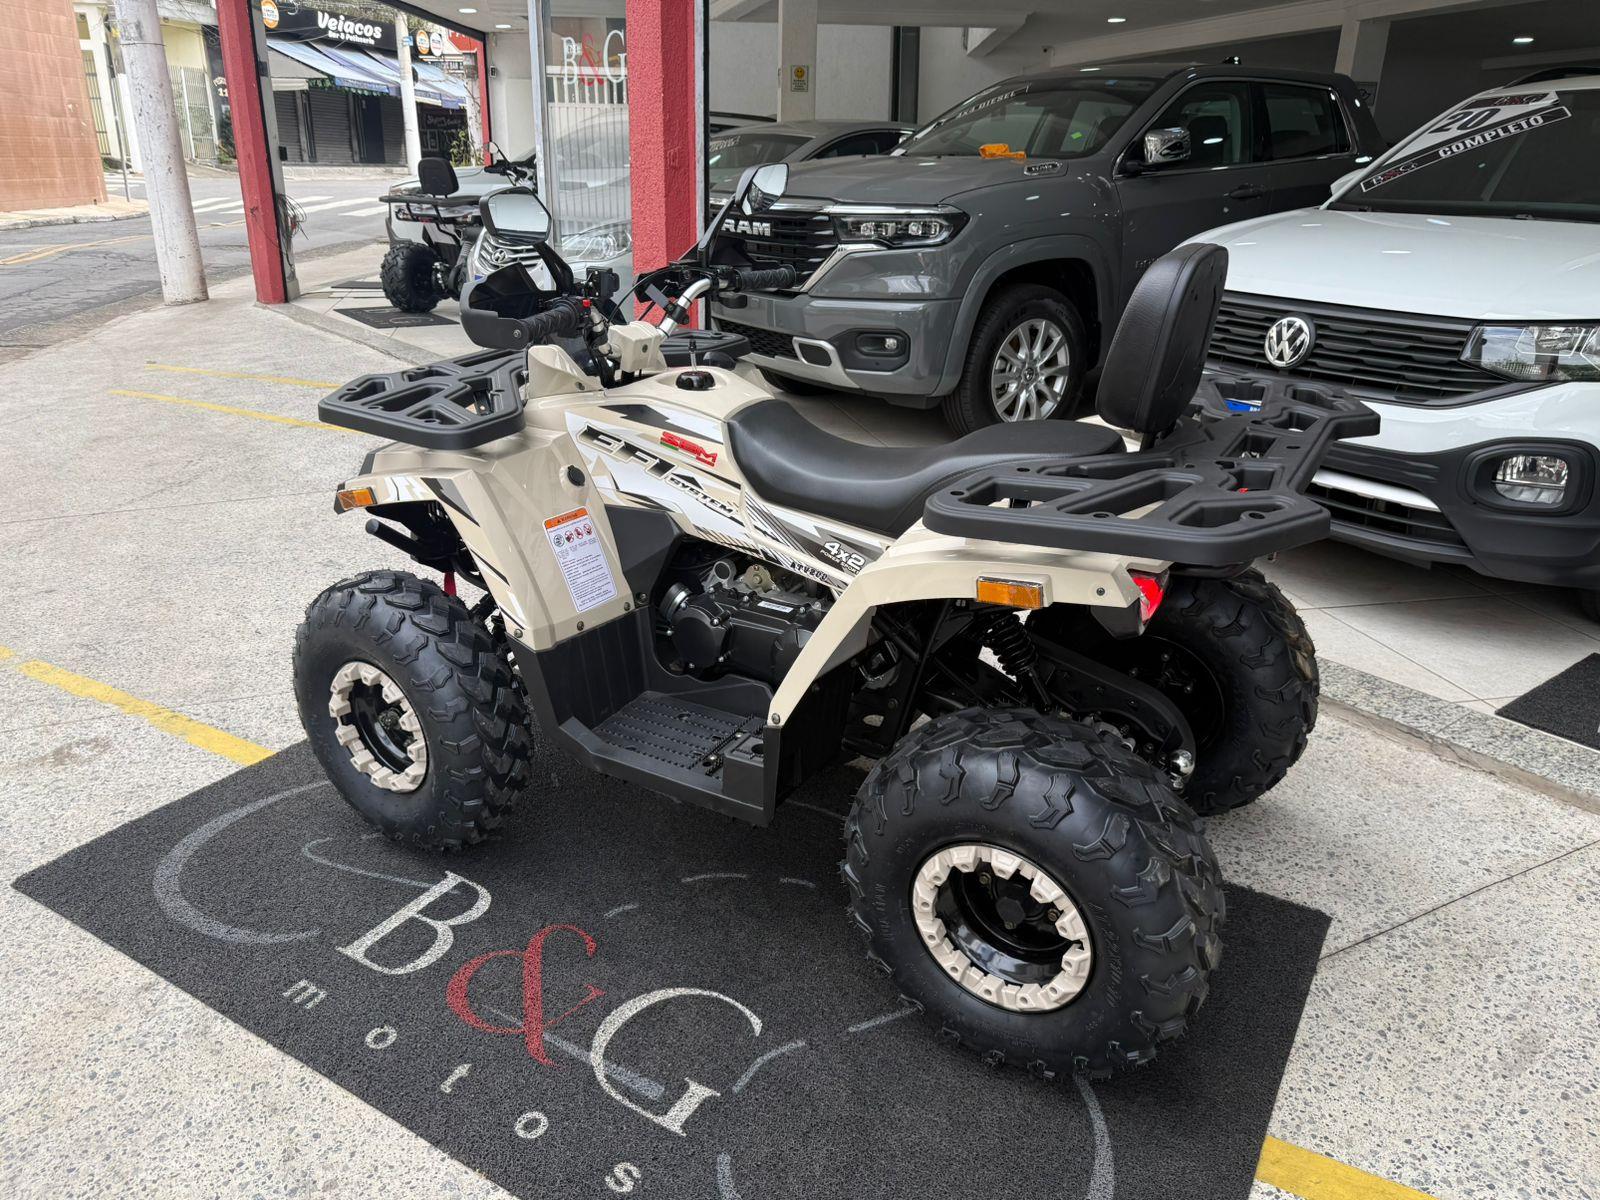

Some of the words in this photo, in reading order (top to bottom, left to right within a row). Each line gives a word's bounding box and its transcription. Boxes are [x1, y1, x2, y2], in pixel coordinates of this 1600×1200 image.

[317, 10, 382, 39] Veiacos
[1438, 115, 1544, 158] COMPLETO
[721, 218, 771, 237] RAM
[668, 475, 735, 515] SYSTEM
[824, 541, 865, 571] 4x2
[336, 870, 763, 1137] B&G
